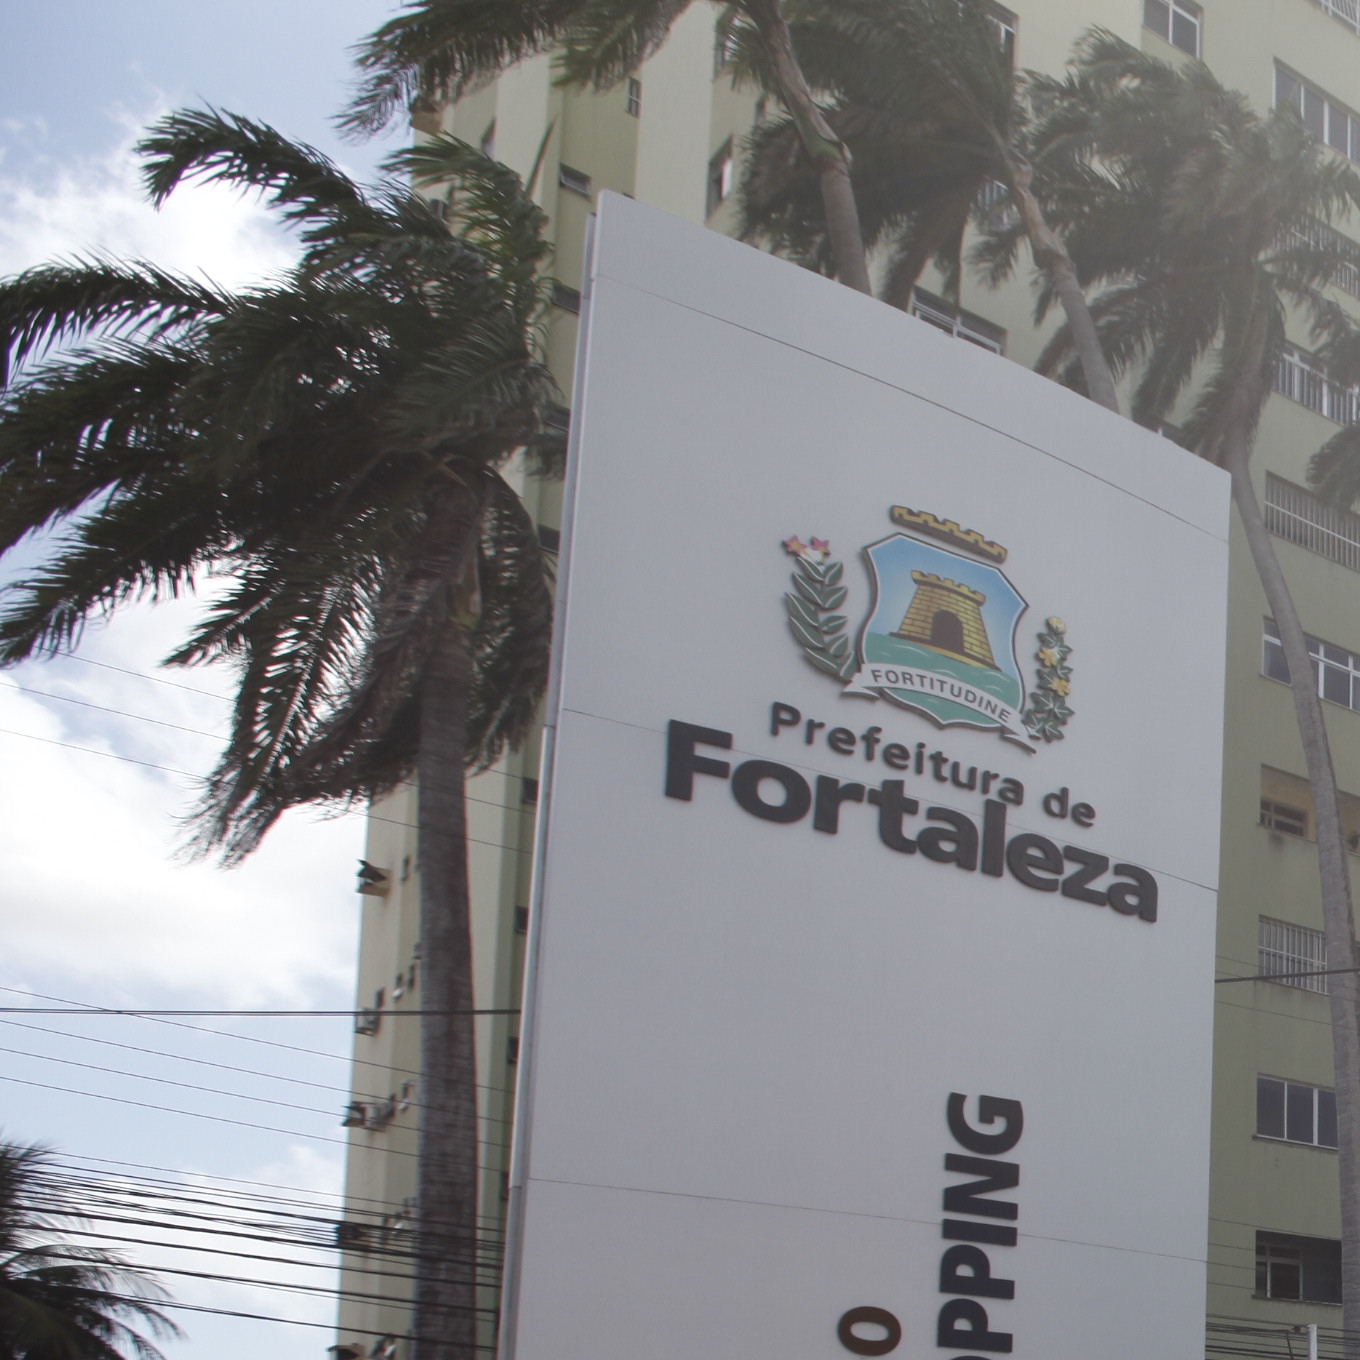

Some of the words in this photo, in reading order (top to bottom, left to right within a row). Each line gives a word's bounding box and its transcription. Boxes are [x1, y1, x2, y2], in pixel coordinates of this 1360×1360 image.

[871, 669, 1012, 723] FORTITUDINE
[664, 718, 1159, 923] Fortaleza
[770, 701, 1026, 806] Prefeitura
[1043, 786, 1097, 828] de
